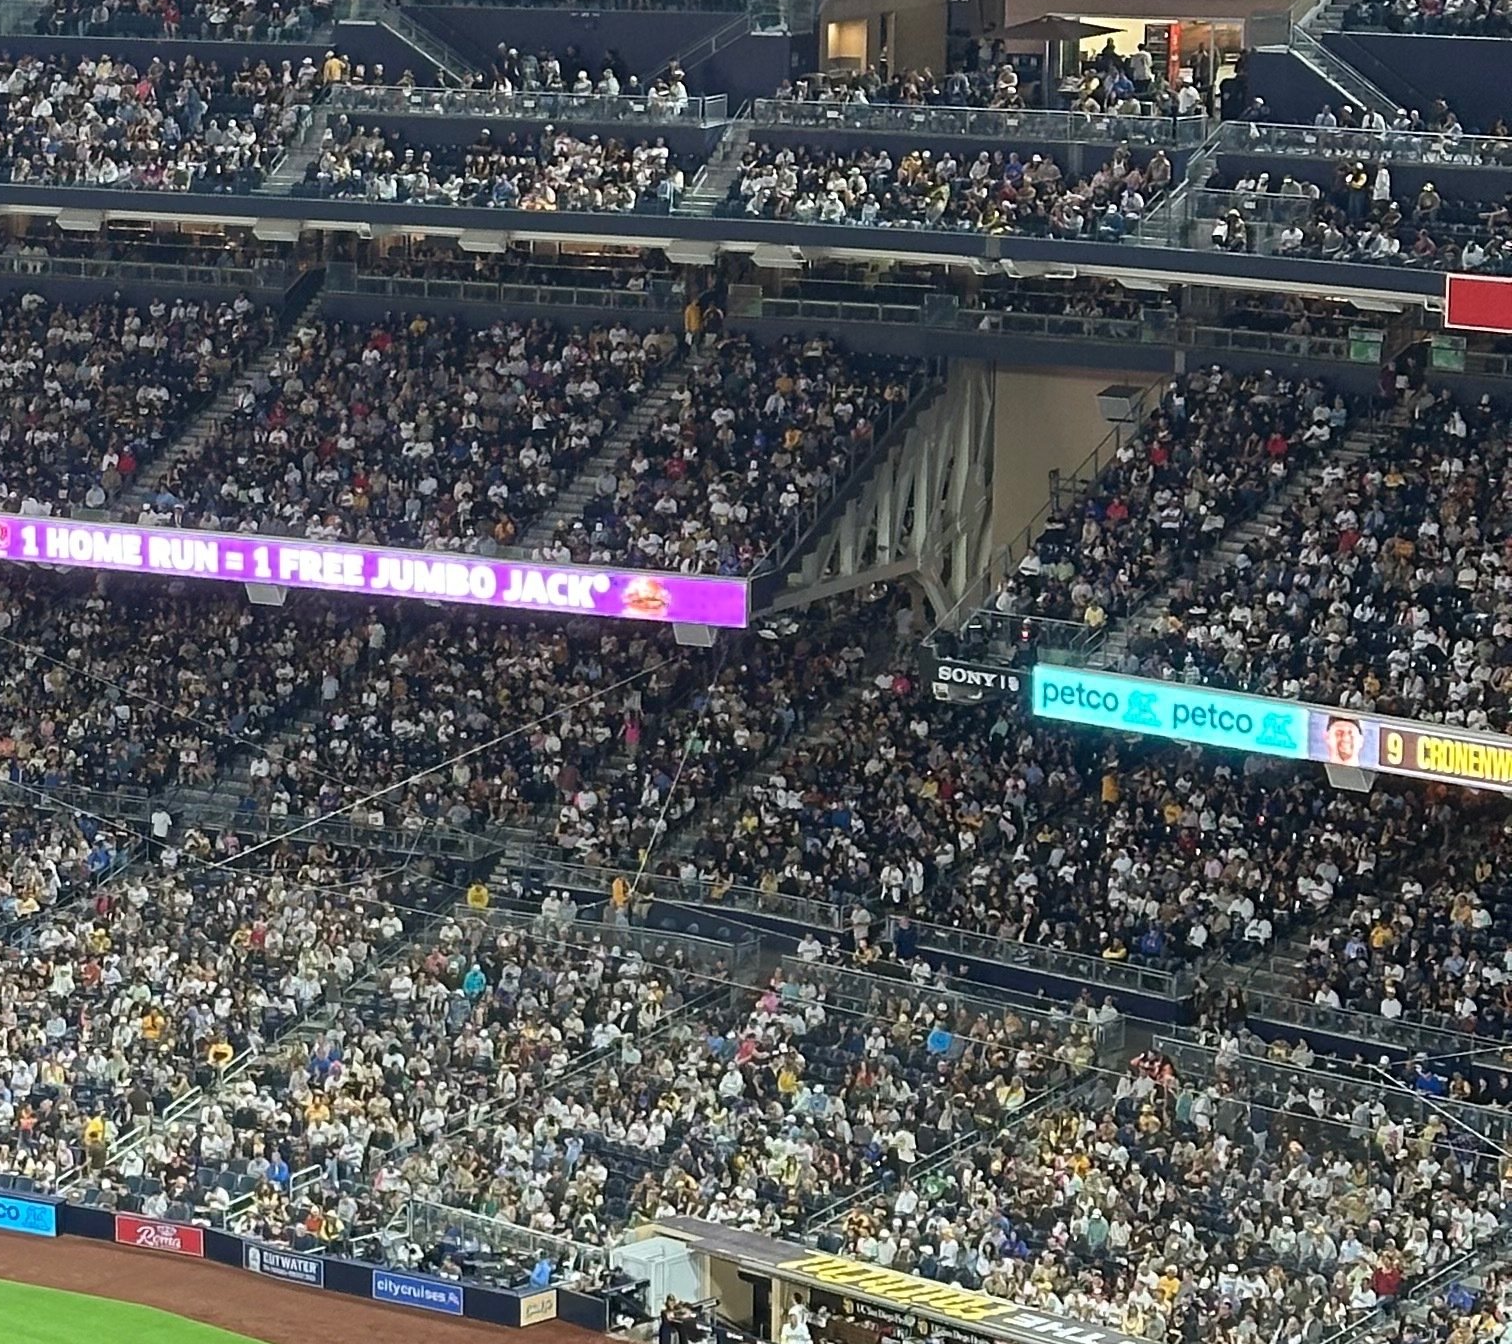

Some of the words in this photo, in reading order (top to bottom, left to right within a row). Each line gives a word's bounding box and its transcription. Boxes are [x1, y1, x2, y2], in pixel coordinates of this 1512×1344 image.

[21, 525, 38, 556] 1
[46, 527, 142, 567] HOME
[148, 537, 219, 573] RUN
[253, 548, 271, 578] 1
[279, 548, 366, 587] FREE
[370, 557, 496, 599] JUMBO
[938, 665, 998, 687] SONY
[1043, 680, 1119, 712] petco
[1173, 701, 1253, 734] petco
[1387, 733, 1404, 765] 9
[262, 1251, 317, 1274] CUTWATER
